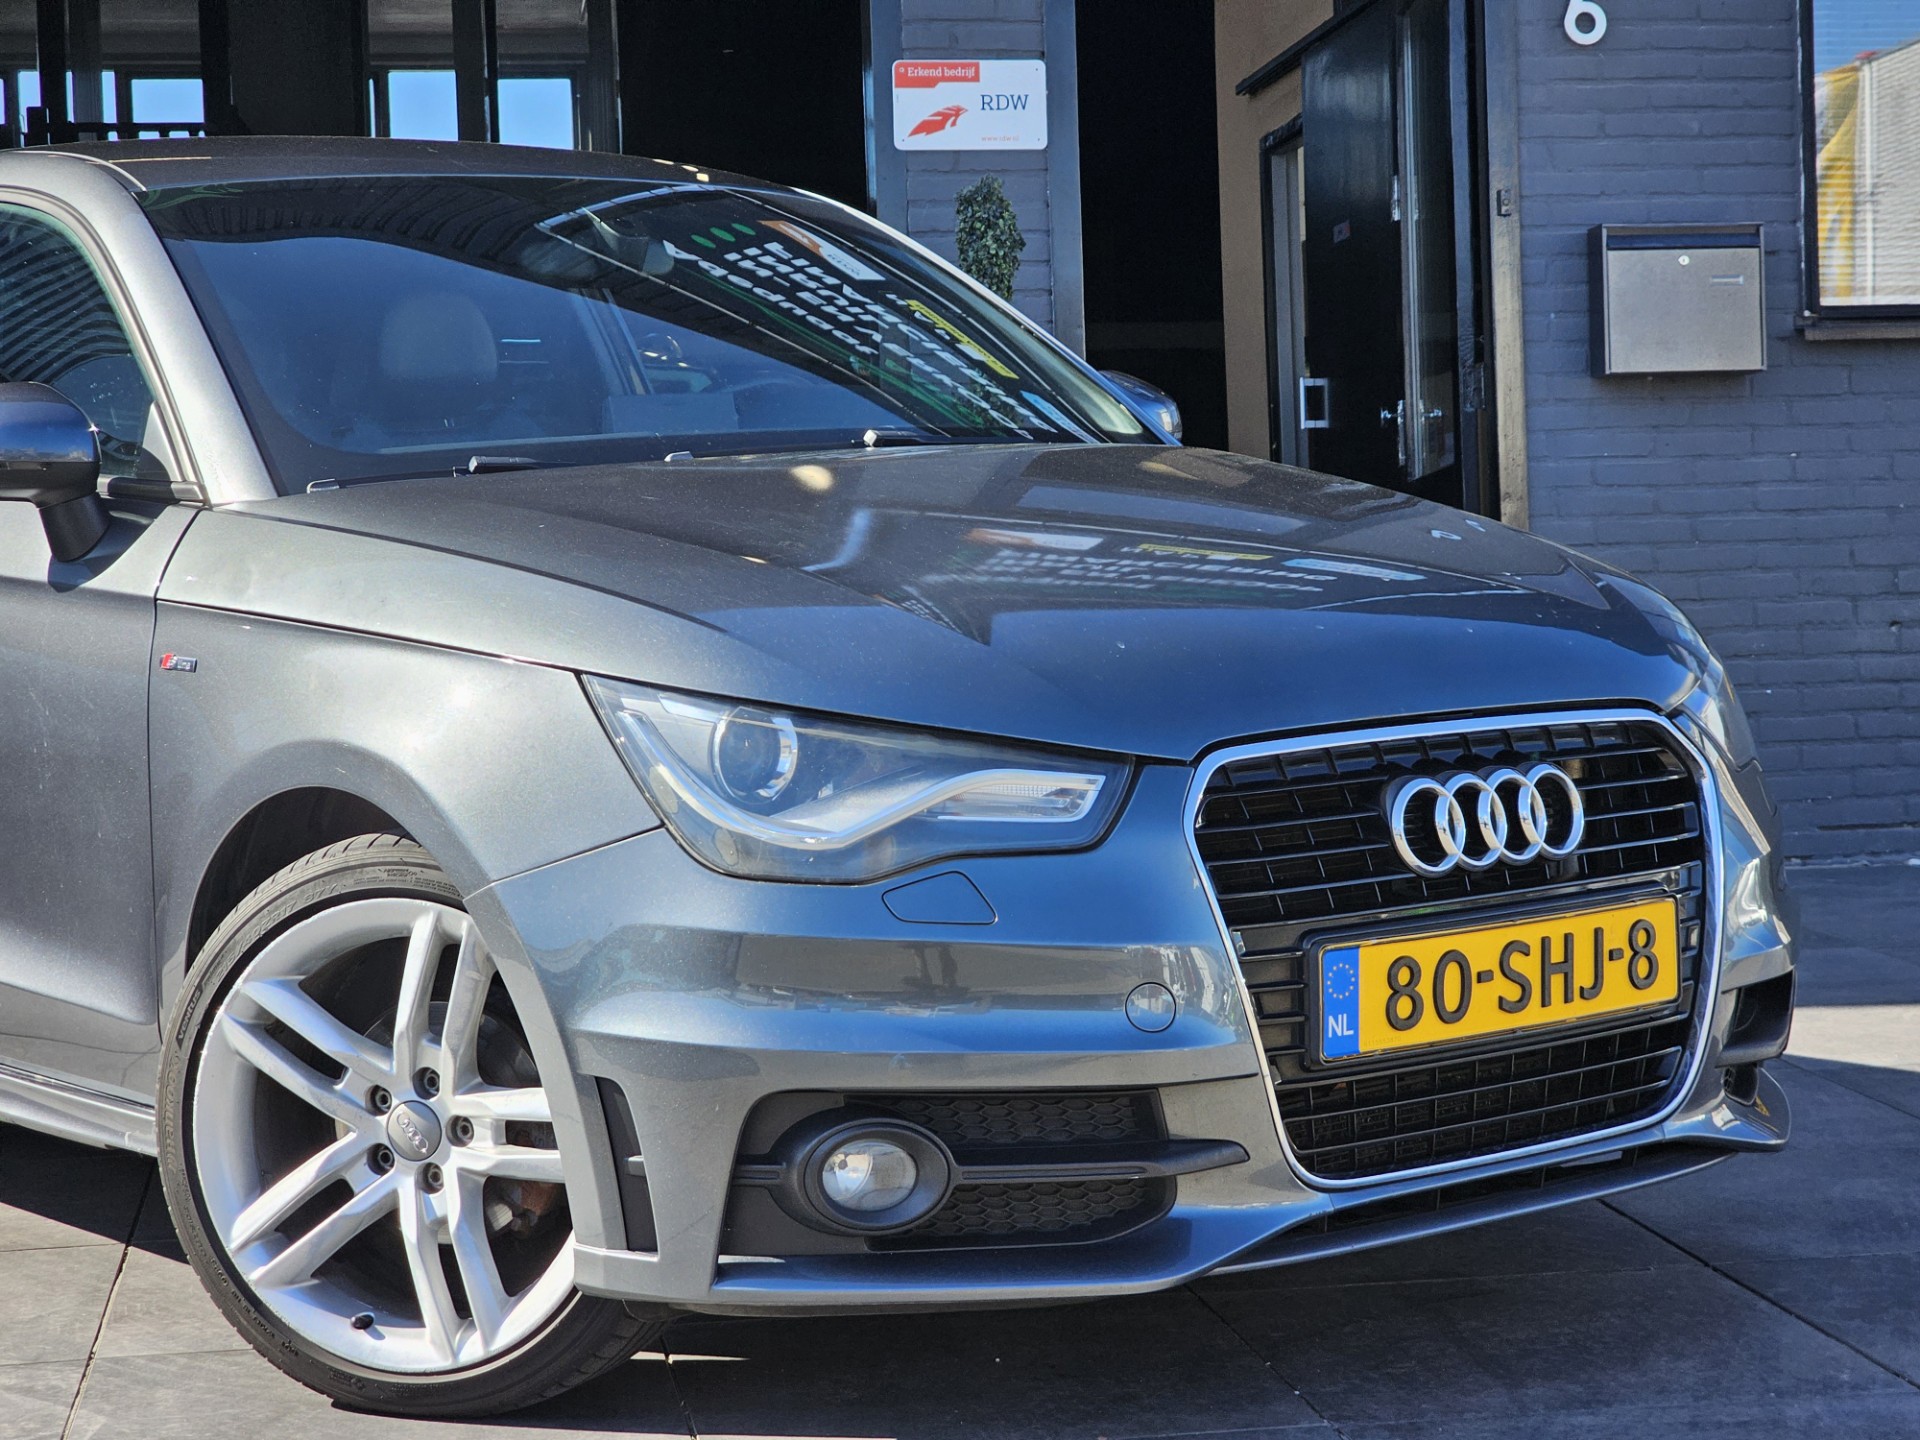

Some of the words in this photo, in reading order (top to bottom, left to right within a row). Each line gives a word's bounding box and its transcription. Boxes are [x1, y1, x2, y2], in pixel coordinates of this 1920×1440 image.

[1564, 0, 1607, 45] 6
[907, 66, 942, 77] Erkend
[943, 66, 976, 79] bedrijf
[980, 94, 1029, 111] RDW
[1385, 918, 1660, 1032] 80-SHJ-8
[1328, 1013, 1354, 1038] NL
